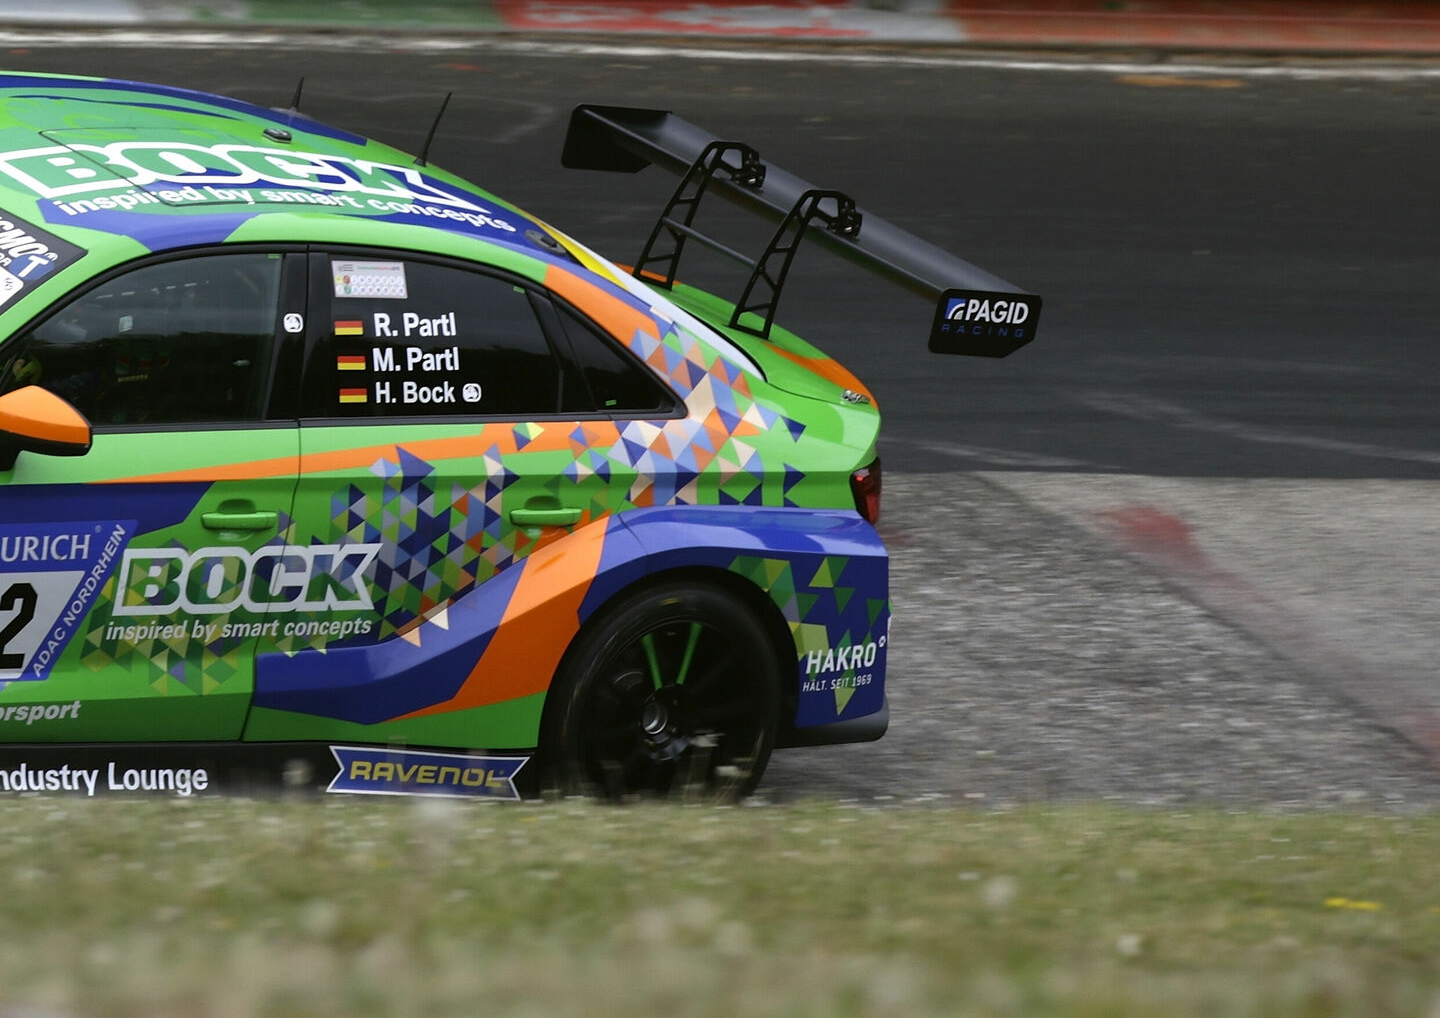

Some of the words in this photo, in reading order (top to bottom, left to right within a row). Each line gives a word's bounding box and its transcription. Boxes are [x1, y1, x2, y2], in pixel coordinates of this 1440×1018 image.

[52, 185, 207, 216] inspired
[205, 186, 256, 205] by
[261, 190, 364, 208] smart
[366, 198, 517, 233] concepts
[373, 312, 399, 337] R.
[403, 312, 457, 337] Partl
[965, 299, 1029, 324] PAGID
[942, 324, 1025, 338] RACING
[372, 347, 402, 372] M.
[406, 346, 460, 372] Partl
[375, 381, 397, 404] H.
[403, 381, 456, 404] Bock
[112, 543, 384, 616] BOCK
[32, 627, 67, 678] ADAC
[63, 524, 127, 627] NORDRHEIN
[106, 620, 188, 643] inspired
[191, 620, 217, 642] by
[220, 619, 279, 638] smart
[282, 617, 373, 641] concepts
[806, 642, 877, 674] HAKRO
[831, 677, 850, 690] SEIT
[852, 673, 872, 687] 1969
[107, 762, 209, 797] Lounge
[350, 760, 503, 788] RAVENOL
